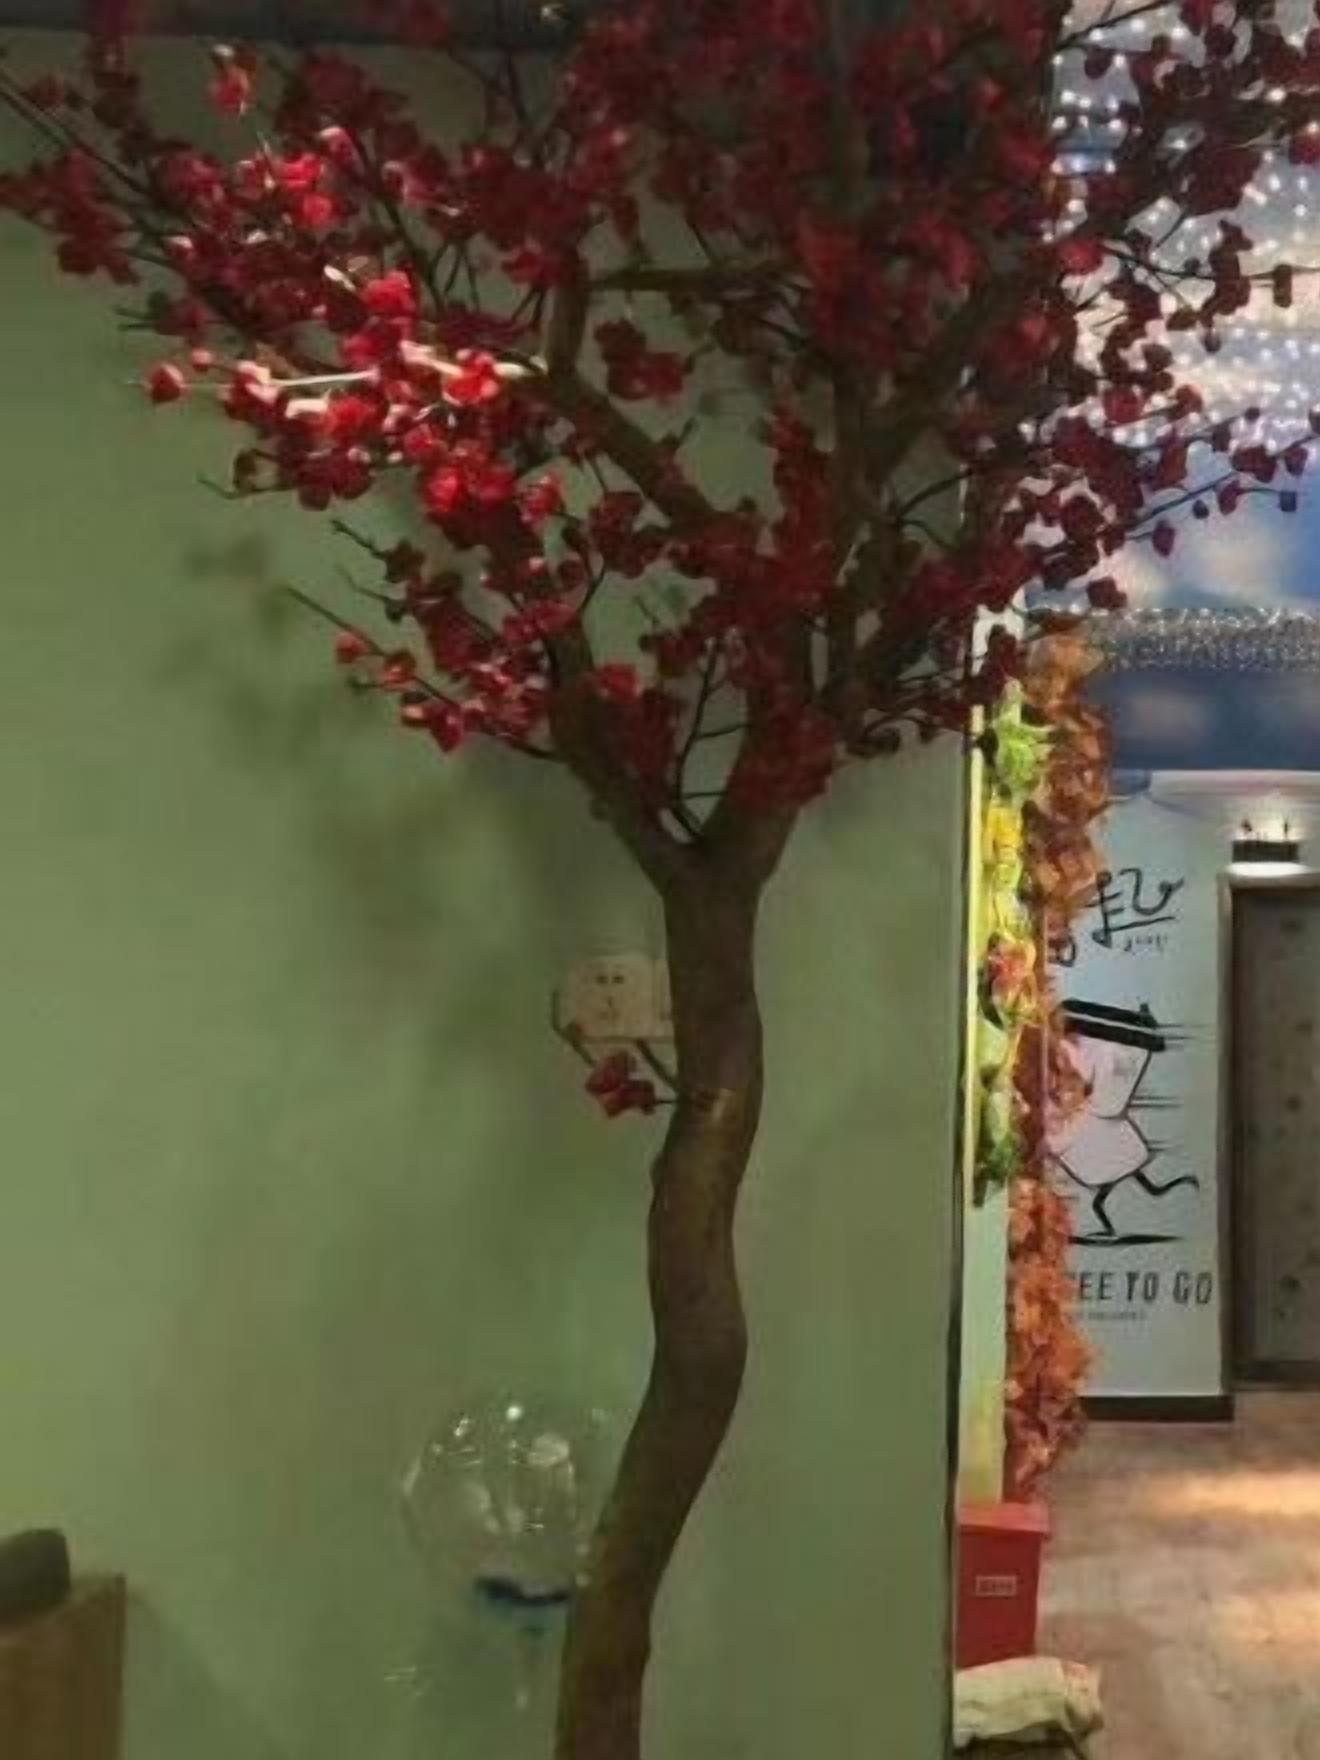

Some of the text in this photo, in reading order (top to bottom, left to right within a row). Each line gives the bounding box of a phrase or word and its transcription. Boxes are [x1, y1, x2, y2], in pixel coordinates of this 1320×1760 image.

[1063, 1270, 1213, 1305] EE TO GO
